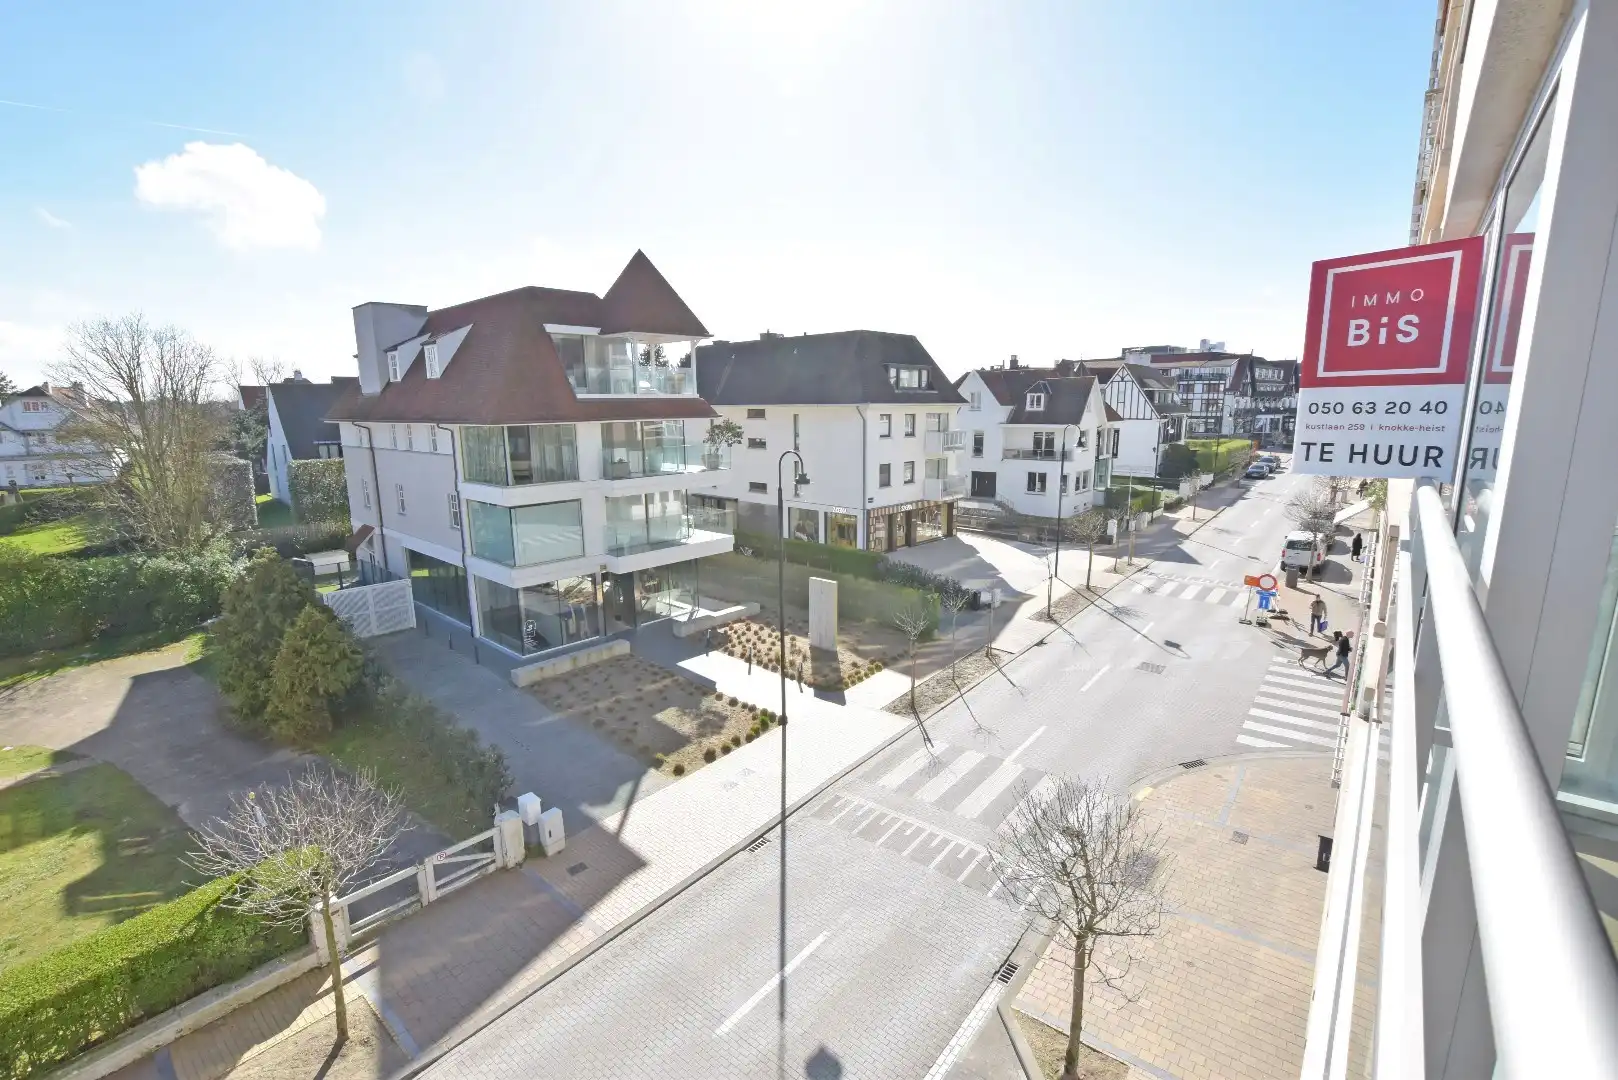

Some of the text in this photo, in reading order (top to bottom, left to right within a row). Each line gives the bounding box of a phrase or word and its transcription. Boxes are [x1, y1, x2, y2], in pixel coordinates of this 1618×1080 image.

[1351, 288, 1424, 308] IMMO
[1347, 314, 1420, 347] BiS
[1308, 400, 1448, 416] 050 63 20 40
[1378, 424, 1446, 433] knokke-heist
[1301, 442, 1444, 469] TE HUUR
